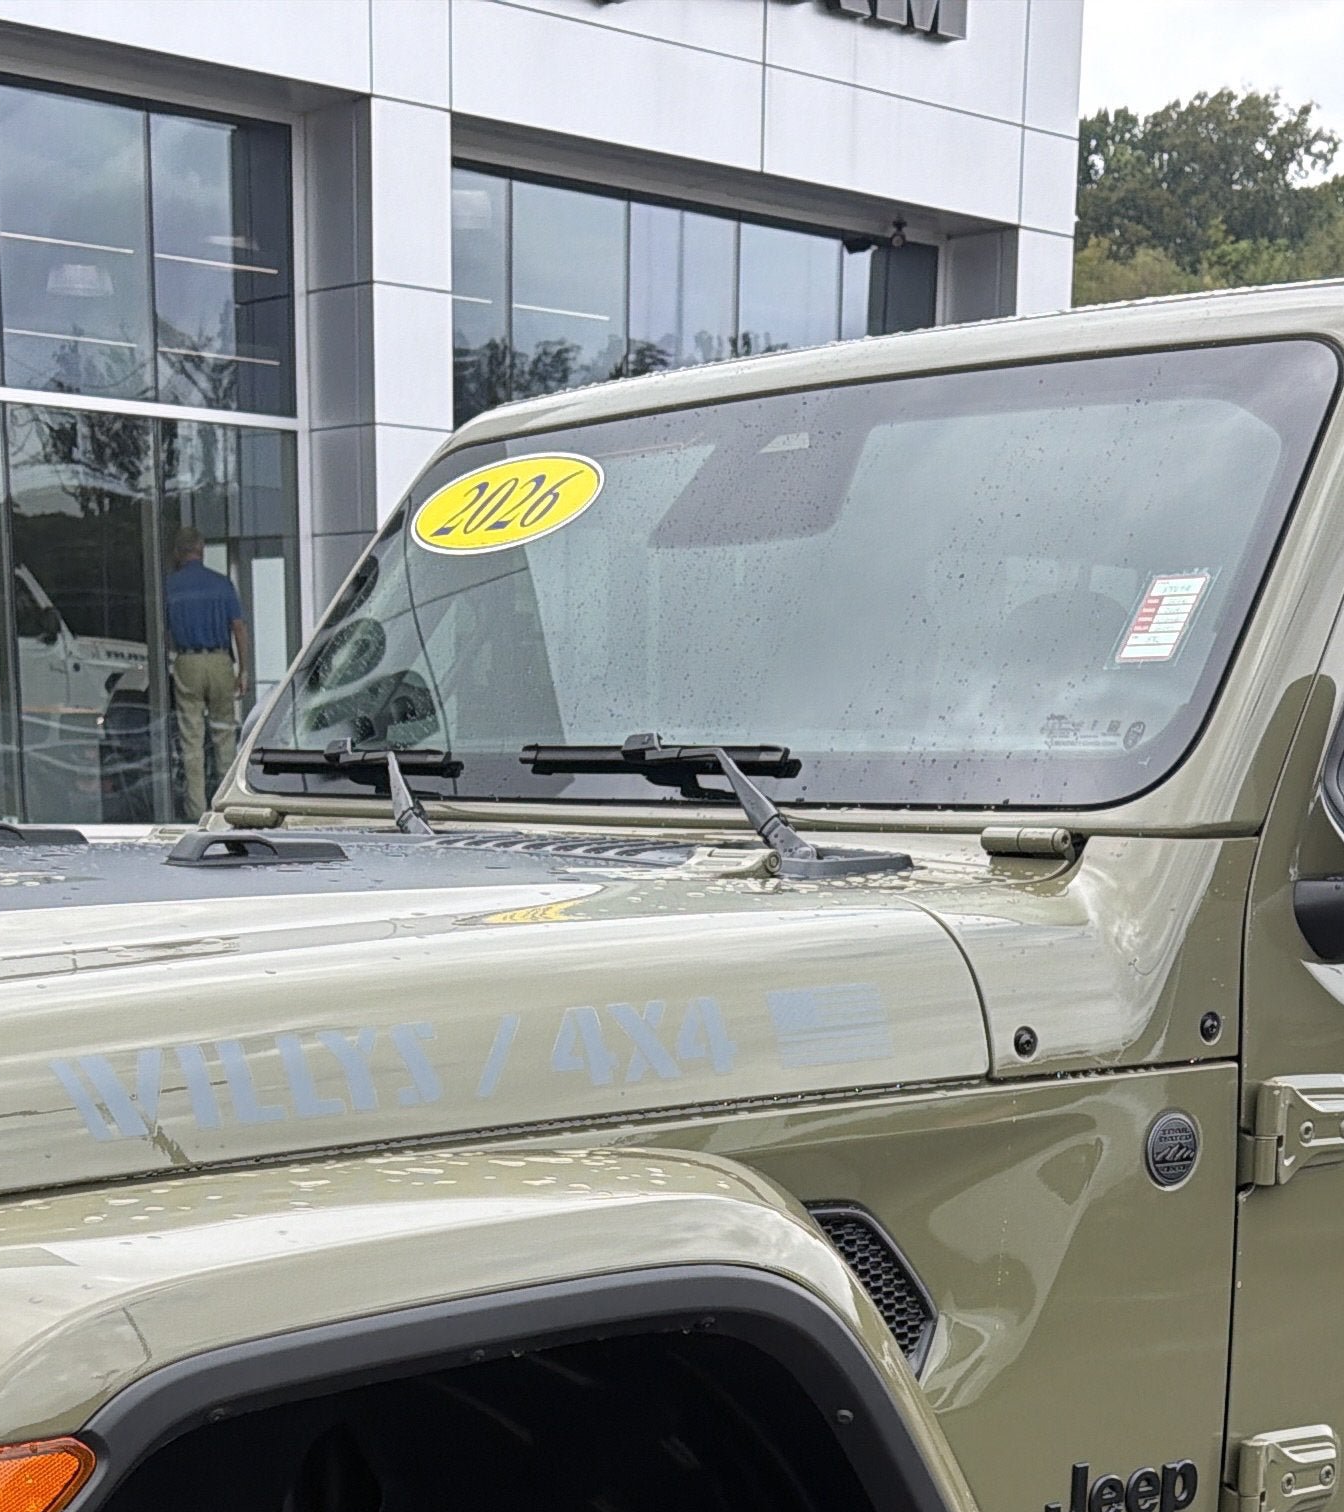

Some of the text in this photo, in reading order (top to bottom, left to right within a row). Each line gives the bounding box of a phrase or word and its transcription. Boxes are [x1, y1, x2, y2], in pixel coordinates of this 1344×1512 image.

[429, 474, 584, 537] 2026
[48, 1003, 443, 1142] WILLYS
[551, 996, 739, 1086] 4X4
